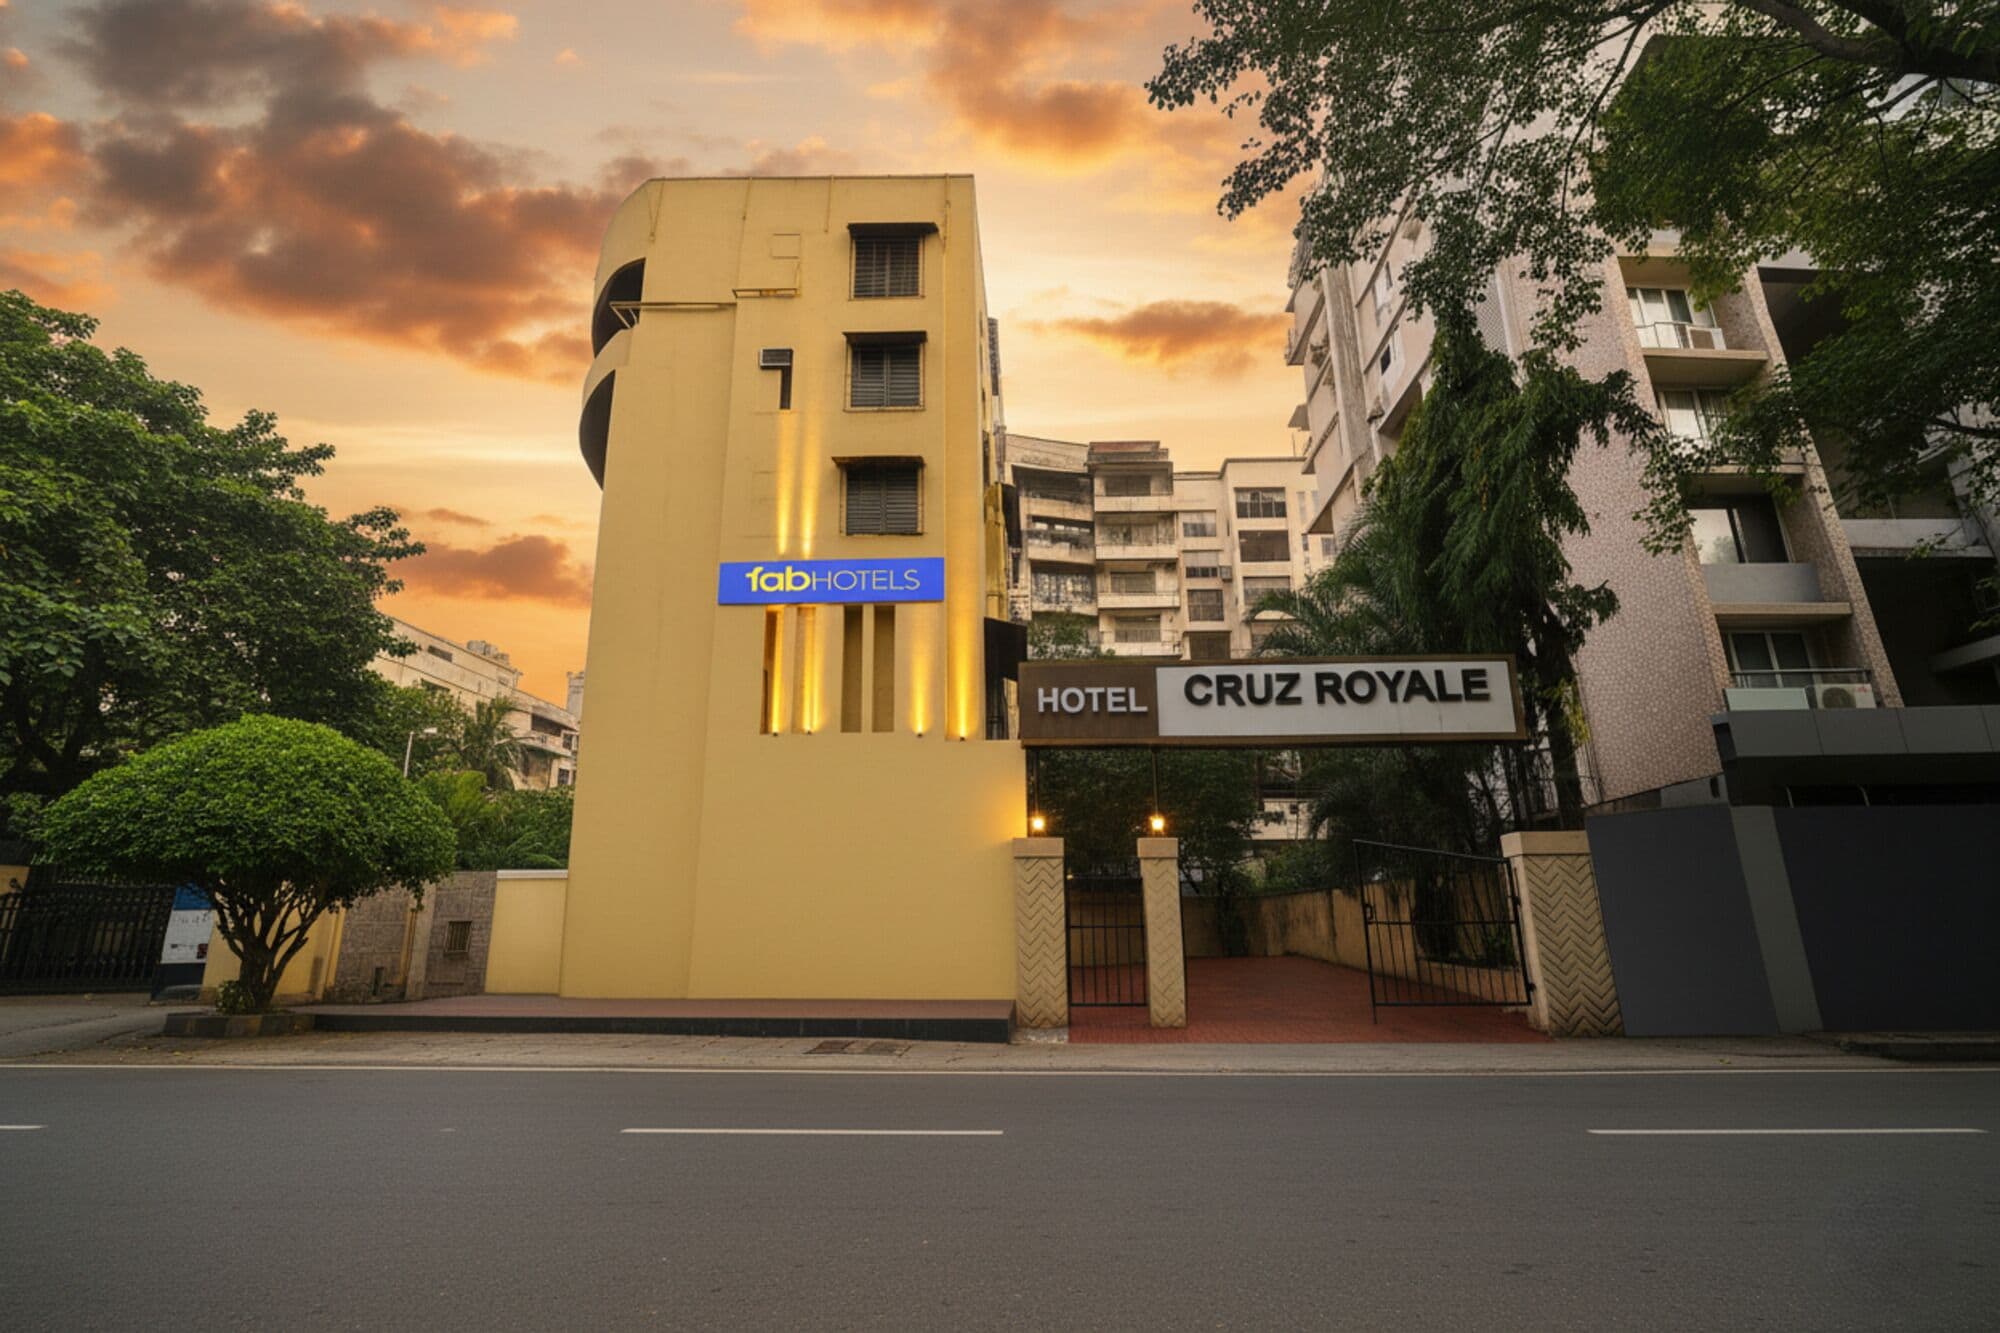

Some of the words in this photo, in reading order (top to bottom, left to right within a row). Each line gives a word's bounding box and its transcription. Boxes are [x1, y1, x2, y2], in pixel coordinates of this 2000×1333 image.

[1037, 686, 1149, 714] HOTEL
[1184, 672, 1303, 707] CRUZ
[1315, 668, 1492, 705] ROYALE
